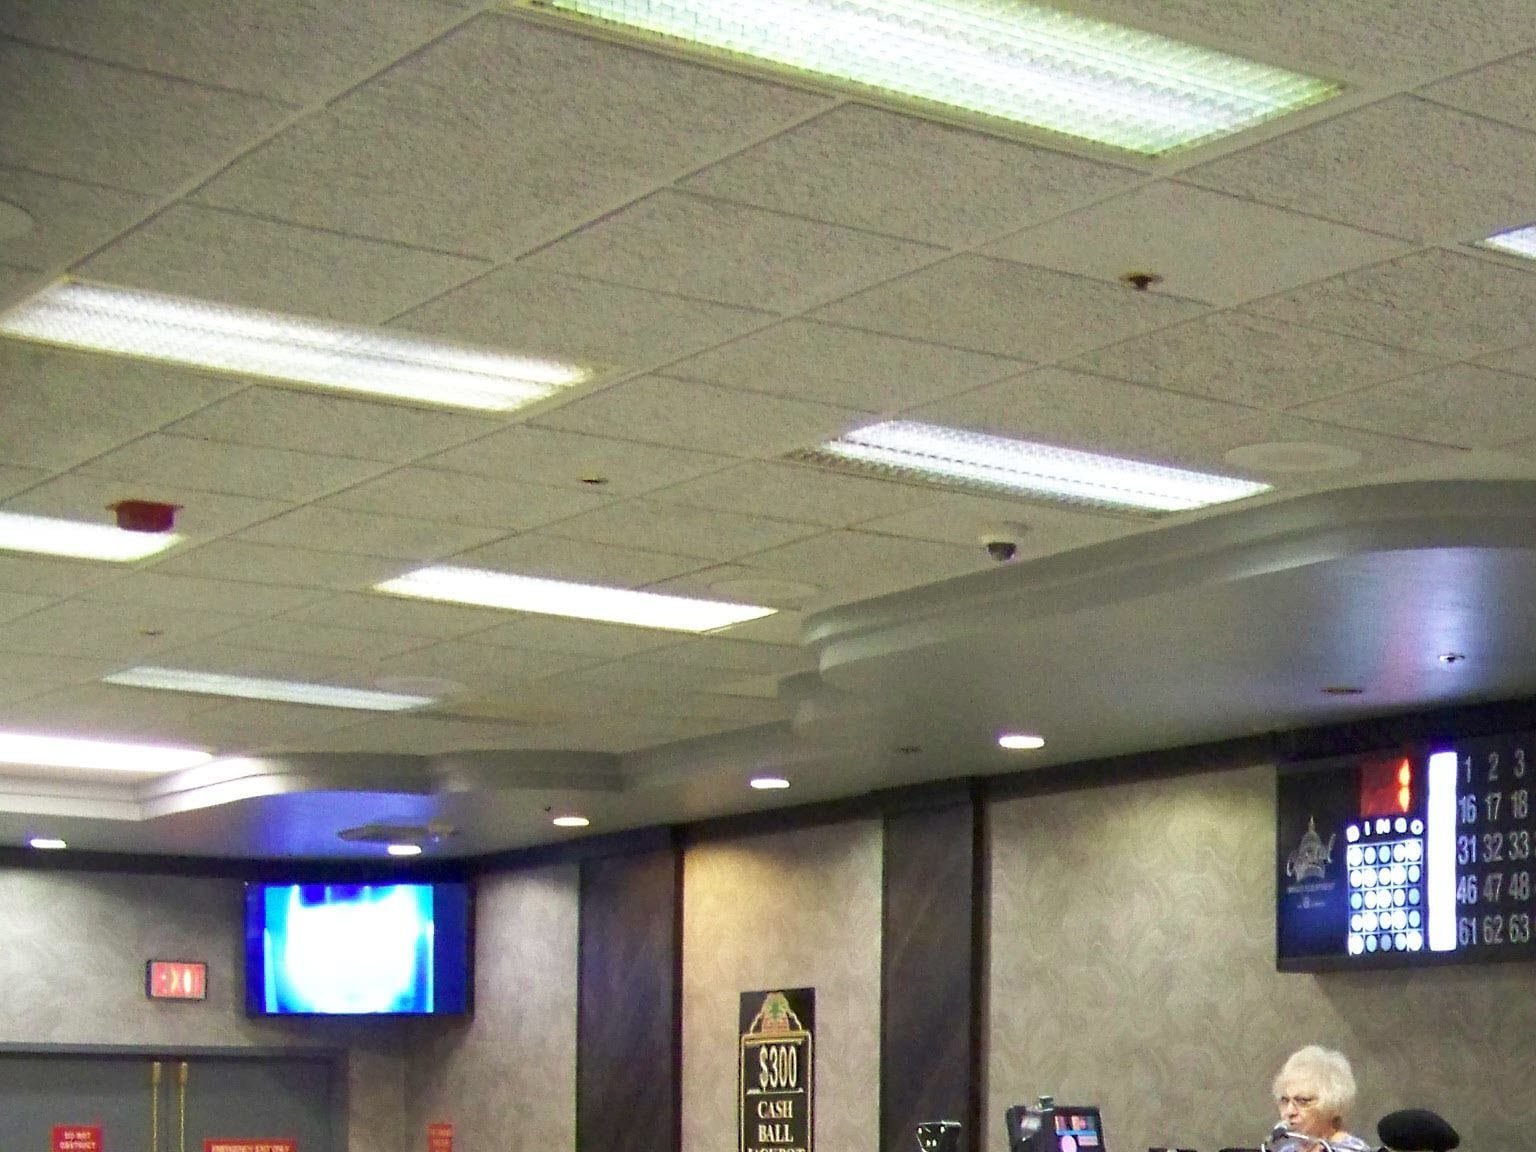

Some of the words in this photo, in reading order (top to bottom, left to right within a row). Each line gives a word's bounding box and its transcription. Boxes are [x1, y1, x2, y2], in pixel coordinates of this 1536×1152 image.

[1488, 752, 1499, 781] 2
[1514, 749, 1525, 778] 3
[1459, 796, 1475, 822] 16
[1485, 792, 1502, 820] 17
[1511, 790, 1528, 818] 18
[1458, 836, 1475, 864] 31
[1483, 833, 1503, 862] 32
[1509, 831, 1529, 860] 33
[1456, 876, 1476, 903] 46
[1483, 873, 1502, 902] 47
[1509, 872, 1530, 900] 48
[1458, 917, 1476, 944] 61
[1483, 915, 1503, 944] 62
[1510, 914, 1530, 942] 63
[759, 1045, 797, 1089] $300
[757, 1100, 793, 1119] CASH
[758, 1124, 794, 1143] BALL
